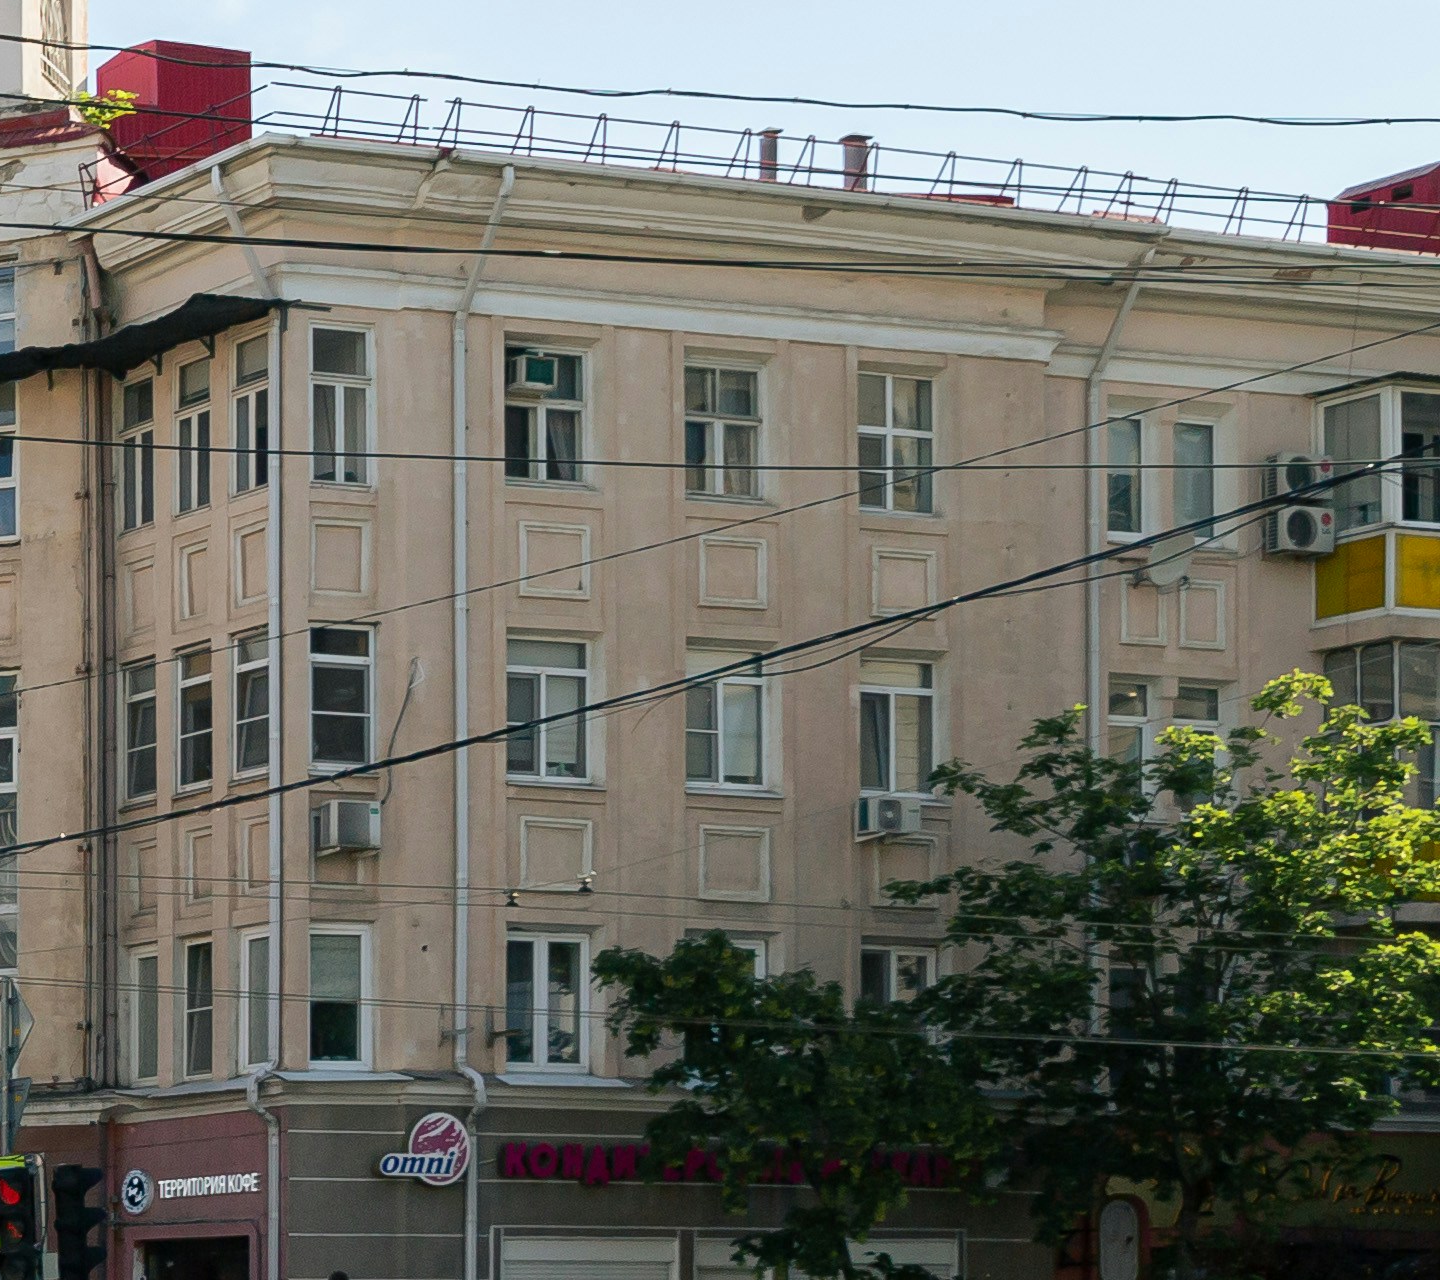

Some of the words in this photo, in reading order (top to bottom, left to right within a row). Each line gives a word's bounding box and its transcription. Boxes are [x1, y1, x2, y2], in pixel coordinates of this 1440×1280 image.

[382, 1151, 456, 1175] omni
[158, 1175, 226, 1199] ТЕРРИТОРИЯ
[227, 1172, 261, 1194] КОФЕ
